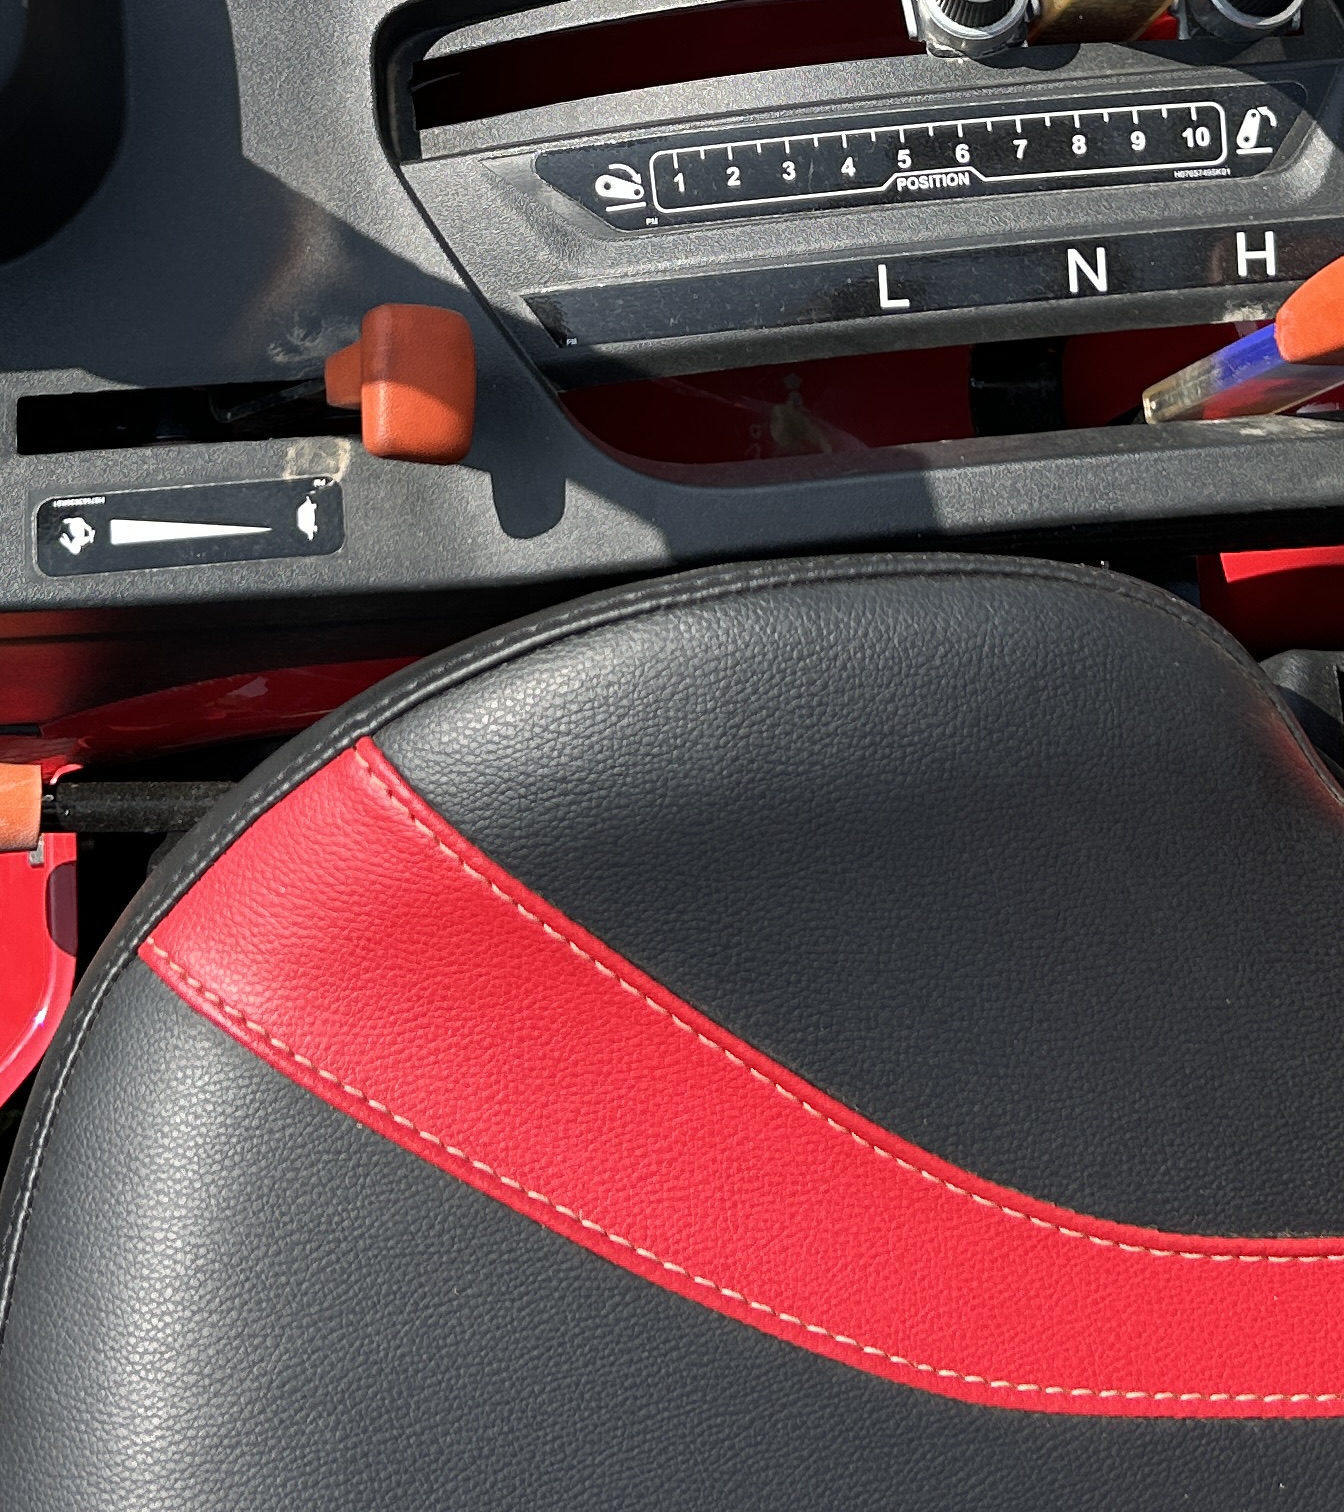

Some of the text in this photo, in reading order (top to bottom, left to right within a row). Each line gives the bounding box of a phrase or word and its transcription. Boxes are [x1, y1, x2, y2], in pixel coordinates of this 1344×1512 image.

[673, 126, 1211, 193] 1 2 3 4 5 6 7 8 9 10
[896, 172, 971, 192] POSITION
[877, 230, 1276, 309] L N H
